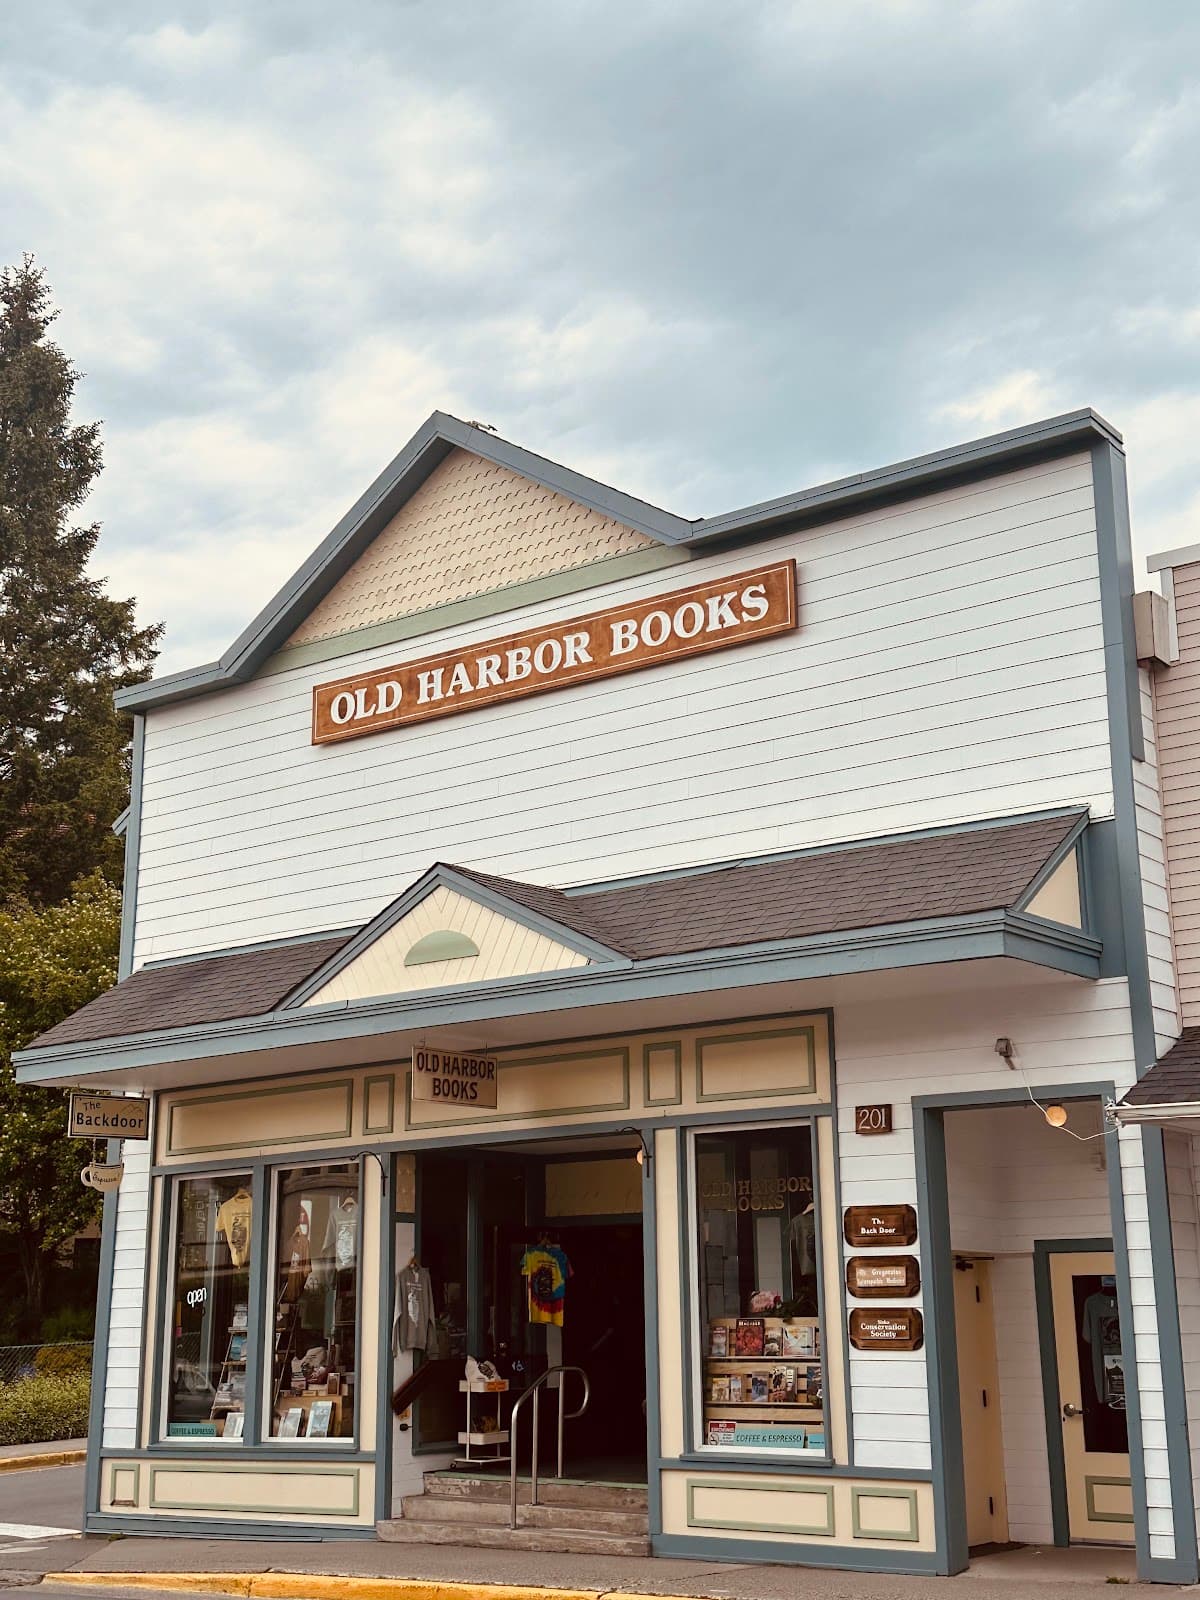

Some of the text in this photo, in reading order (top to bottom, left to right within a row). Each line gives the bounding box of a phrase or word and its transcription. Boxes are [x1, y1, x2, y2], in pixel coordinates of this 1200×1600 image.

[329, 583, 769, 725] OLD HARBOR BOOKS
[416, 1052, 495, 1080] OLD HARBOR
[432, 1077, 478, 1100] BOOKS
[83, 1101, 102, 1111] The
[76, 1112, 144, 1128] Backdoor
[859, 1108, 886, 1130] 201
[871, 1217, 885, 1225] The
[879, 1226, 896, 1234] Door
[186, 1287, 207, 1309] open
[860, 1322, 906, 1331] Conservation
[870, 1330, 897, 1339] Society
[736, 1433, 761, 1443] COFFEE
[768, 1434, 802, 1443] ESPRESSO
